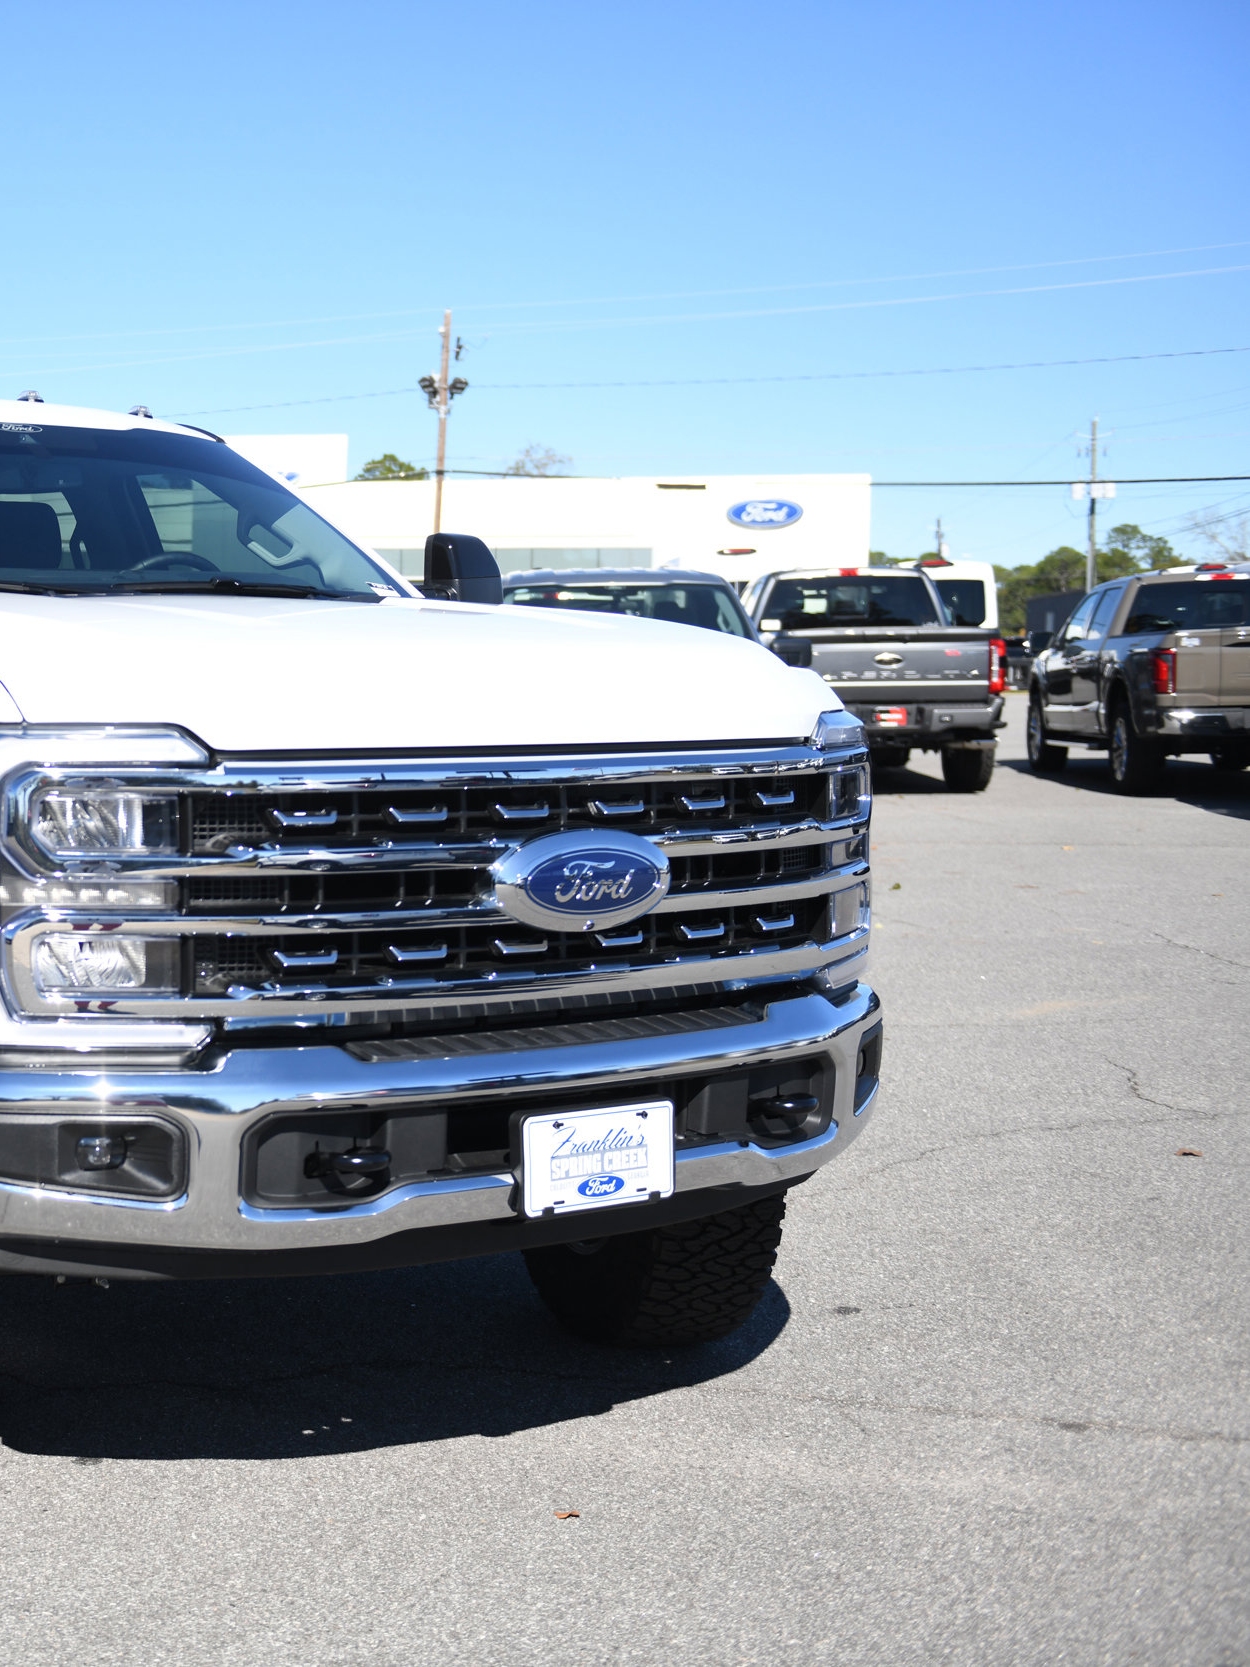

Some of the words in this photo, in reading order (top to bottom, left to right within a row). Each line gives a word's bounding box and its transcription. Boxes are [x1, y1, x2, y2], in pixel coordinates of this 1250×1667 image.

[741, 502, 789, 522] Ford
[555, 860, 635, 903] Ford
[550, 1124, 645, 1159] Franklin's
[551, 1152, 602, 1180] SPRING
[603, 1146, 648, 1172] CREEK
[586, 1177, 616, 1195] Ford
